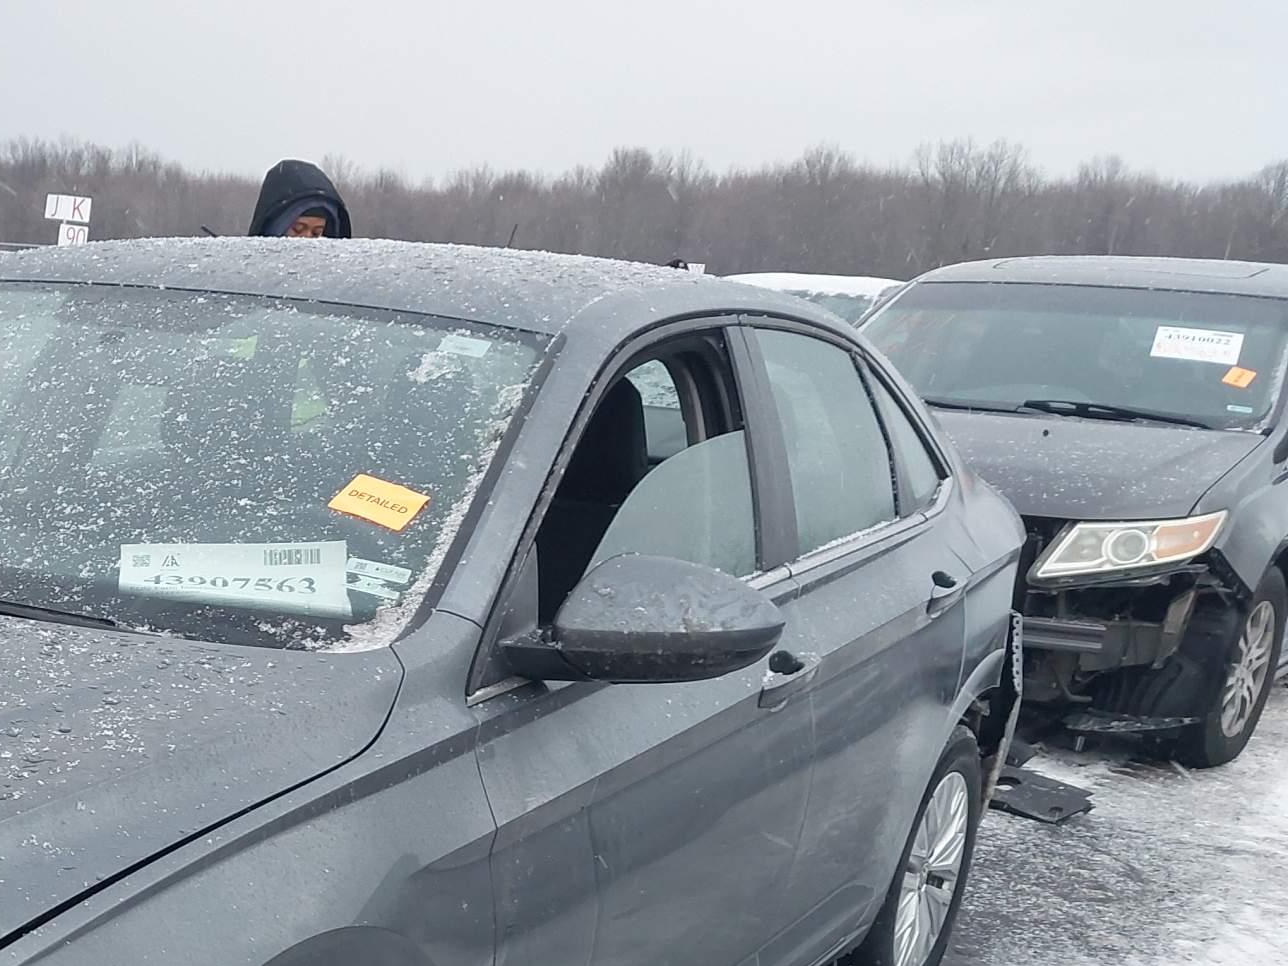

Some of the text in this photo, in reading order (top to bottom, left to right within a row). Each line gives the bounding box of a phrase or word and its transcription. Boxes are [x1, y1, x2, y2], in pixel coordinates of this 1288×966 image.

[51, 196, 86, 220] J K
[66, 226, 86, 246] 90
[348, 489, 409, 515] DETAILED
[143, 574, 317, 595] 43907563
